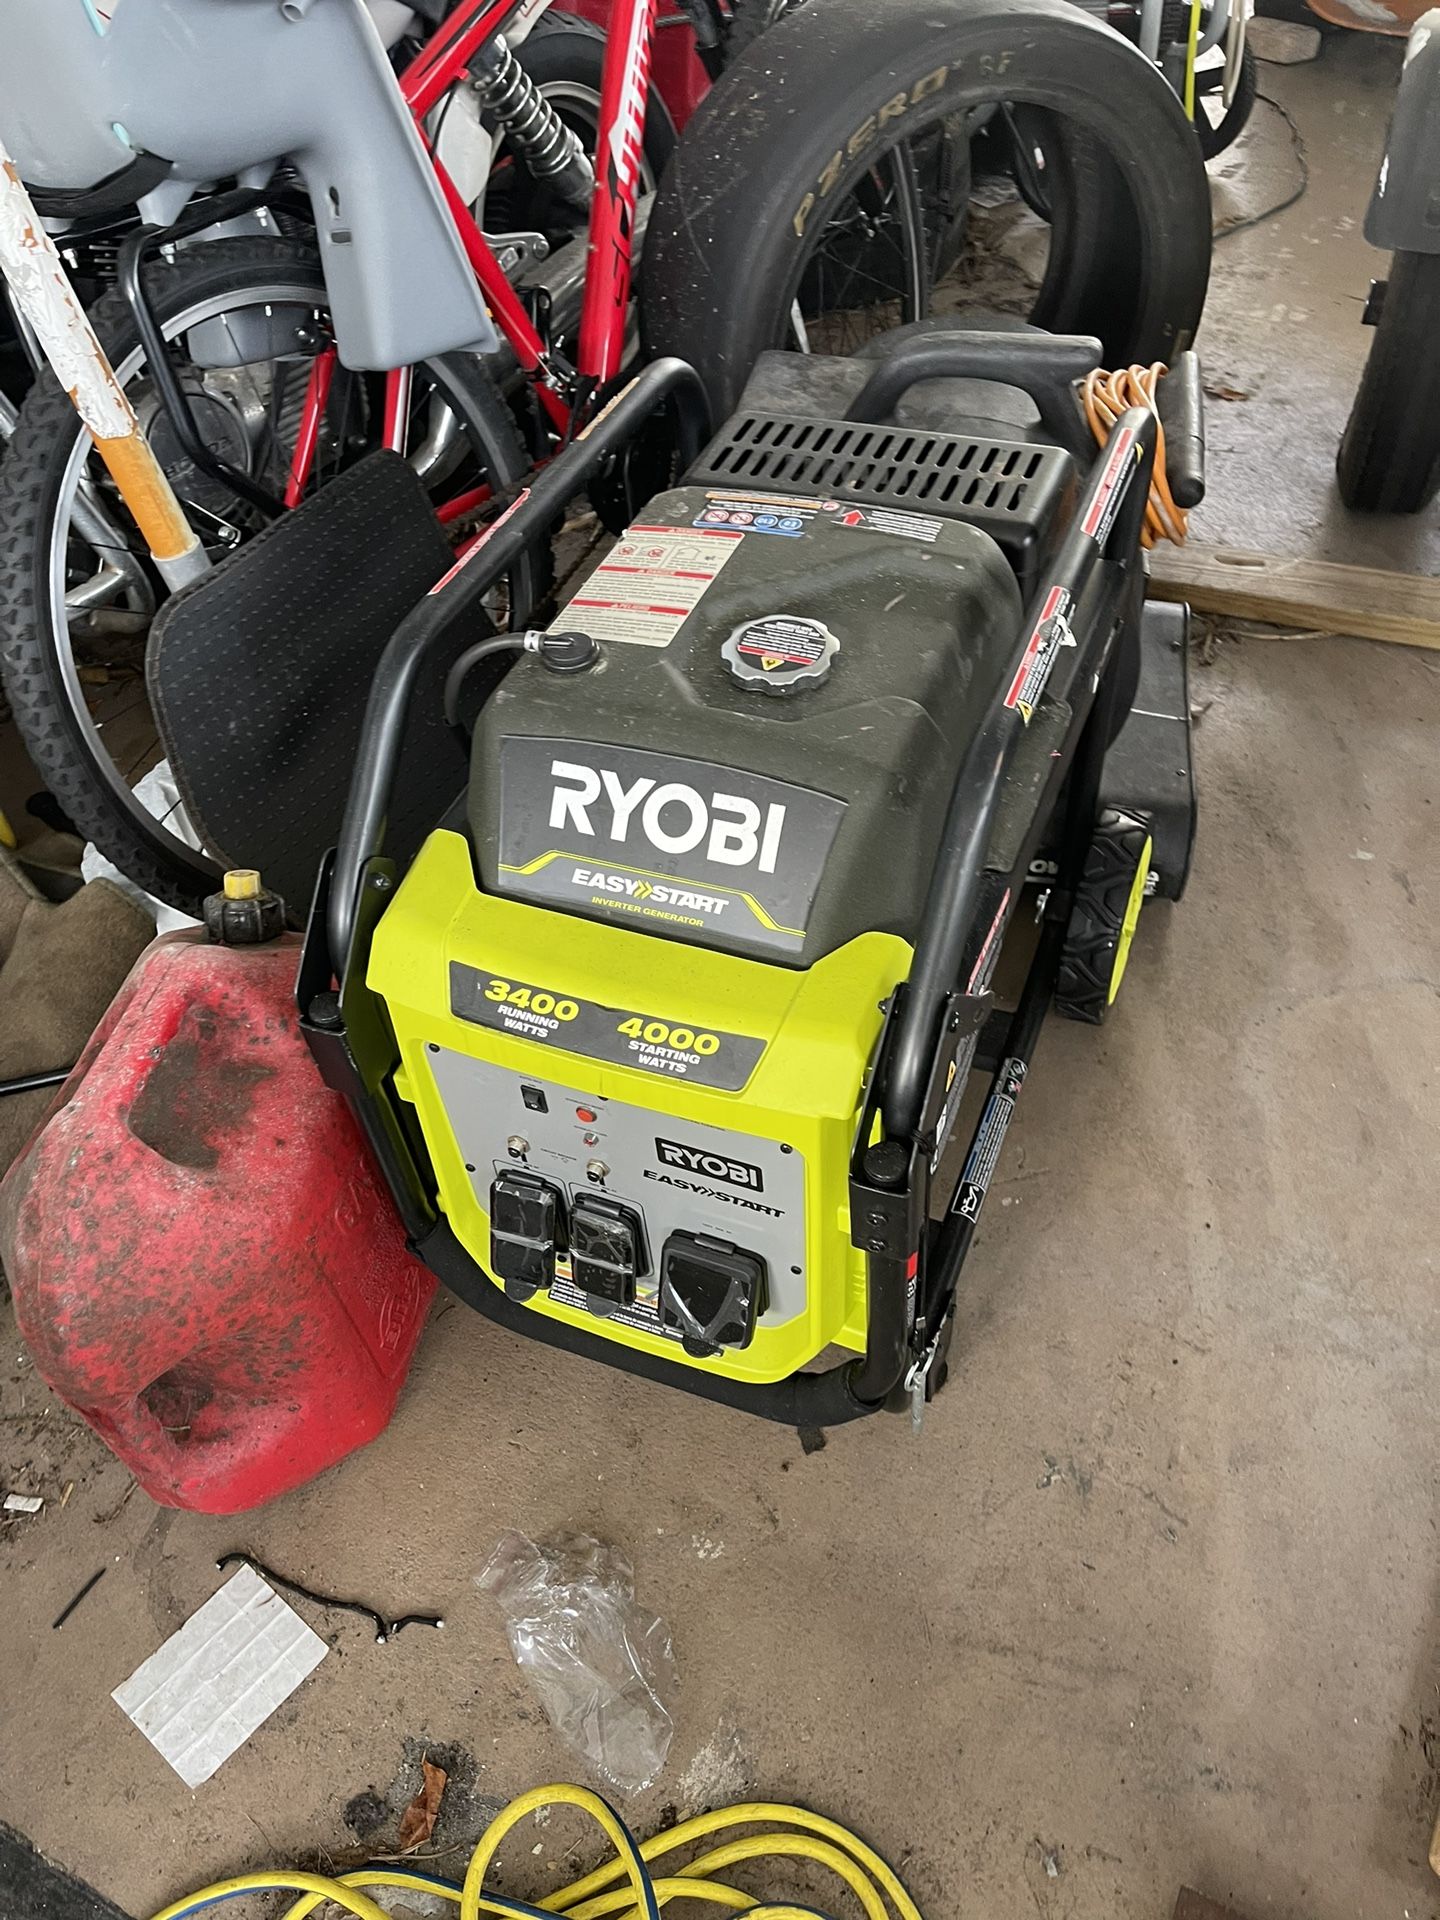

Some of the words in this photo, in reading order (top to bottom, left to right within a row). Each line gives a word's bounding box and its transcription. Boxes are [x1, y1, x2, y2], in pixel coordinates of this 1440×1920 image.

[549, 760, 786, 874] RYOBI
[592, 896, 641, 914] INVERTER
[643, 908, 704, 927] GENERATOR
[650, 885, 729, 915] START
[484, 980, 579, 1021] 3400
[497, 1004, 559, 1029] RUNNING
[503, 1017, 549, 1039] WATTS
[617, 1017, 720, 1056] 4000
[628, 1040, 701, 1065] STARTING
[638, 1053, 688, 1074] WATTS
[661, 1143, 759, 1188] RYOBI
[714, 1191, 785, 1218] START
